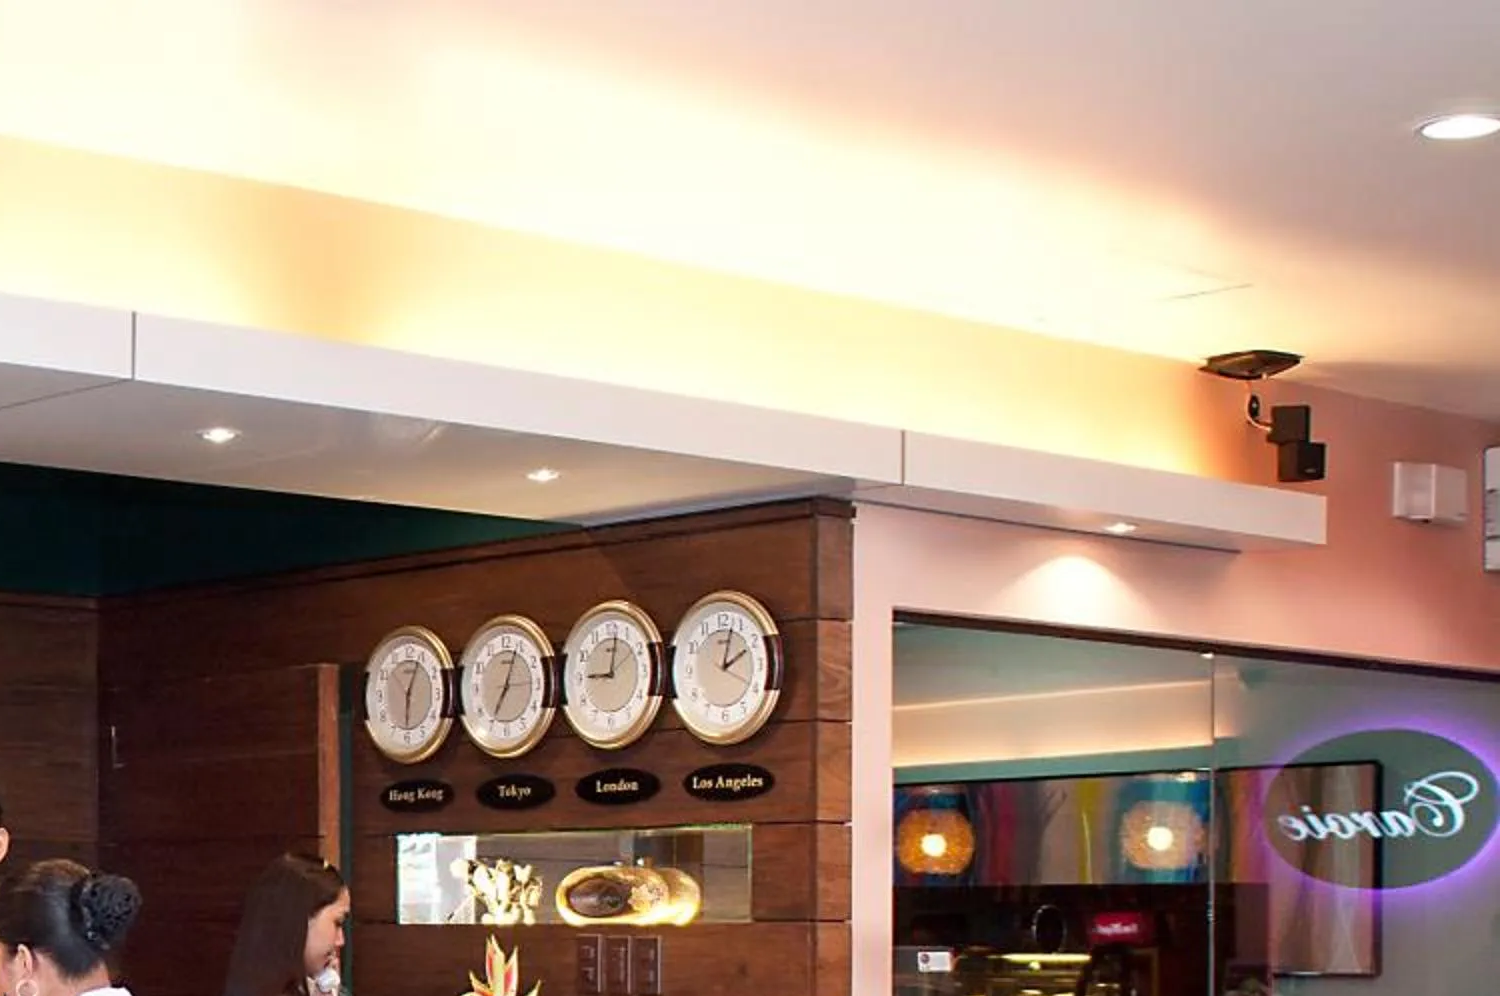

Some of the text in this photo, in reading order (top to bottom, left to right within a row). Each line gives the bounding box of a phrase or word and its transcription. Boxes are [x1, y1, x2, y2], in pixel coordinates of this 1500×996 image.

[596, 778, 639, 793] London
[693, 774, 763, 791] Los Angeles
[389, 788, 444, 803] Hong Kong
[498, 785, 531, 800] Tokyo
